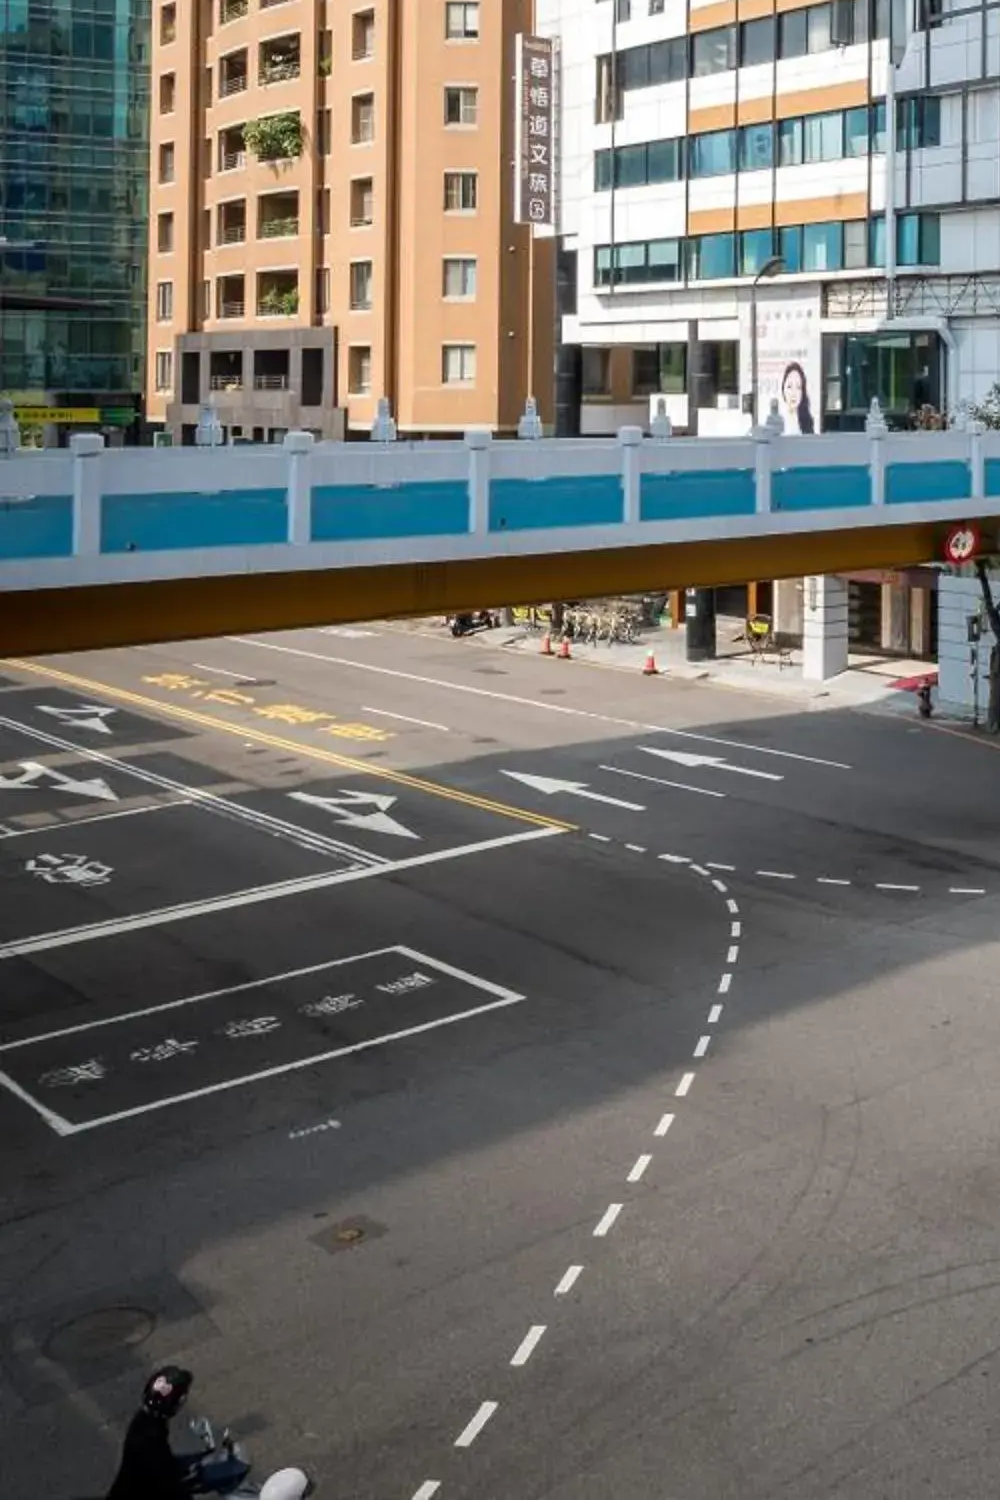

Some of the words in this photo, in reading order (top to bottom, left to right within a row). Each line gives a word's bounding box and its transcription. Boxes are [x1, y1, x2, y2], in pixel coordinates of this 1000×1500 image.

[530, 57, 549, 192] 草悟道文旅
